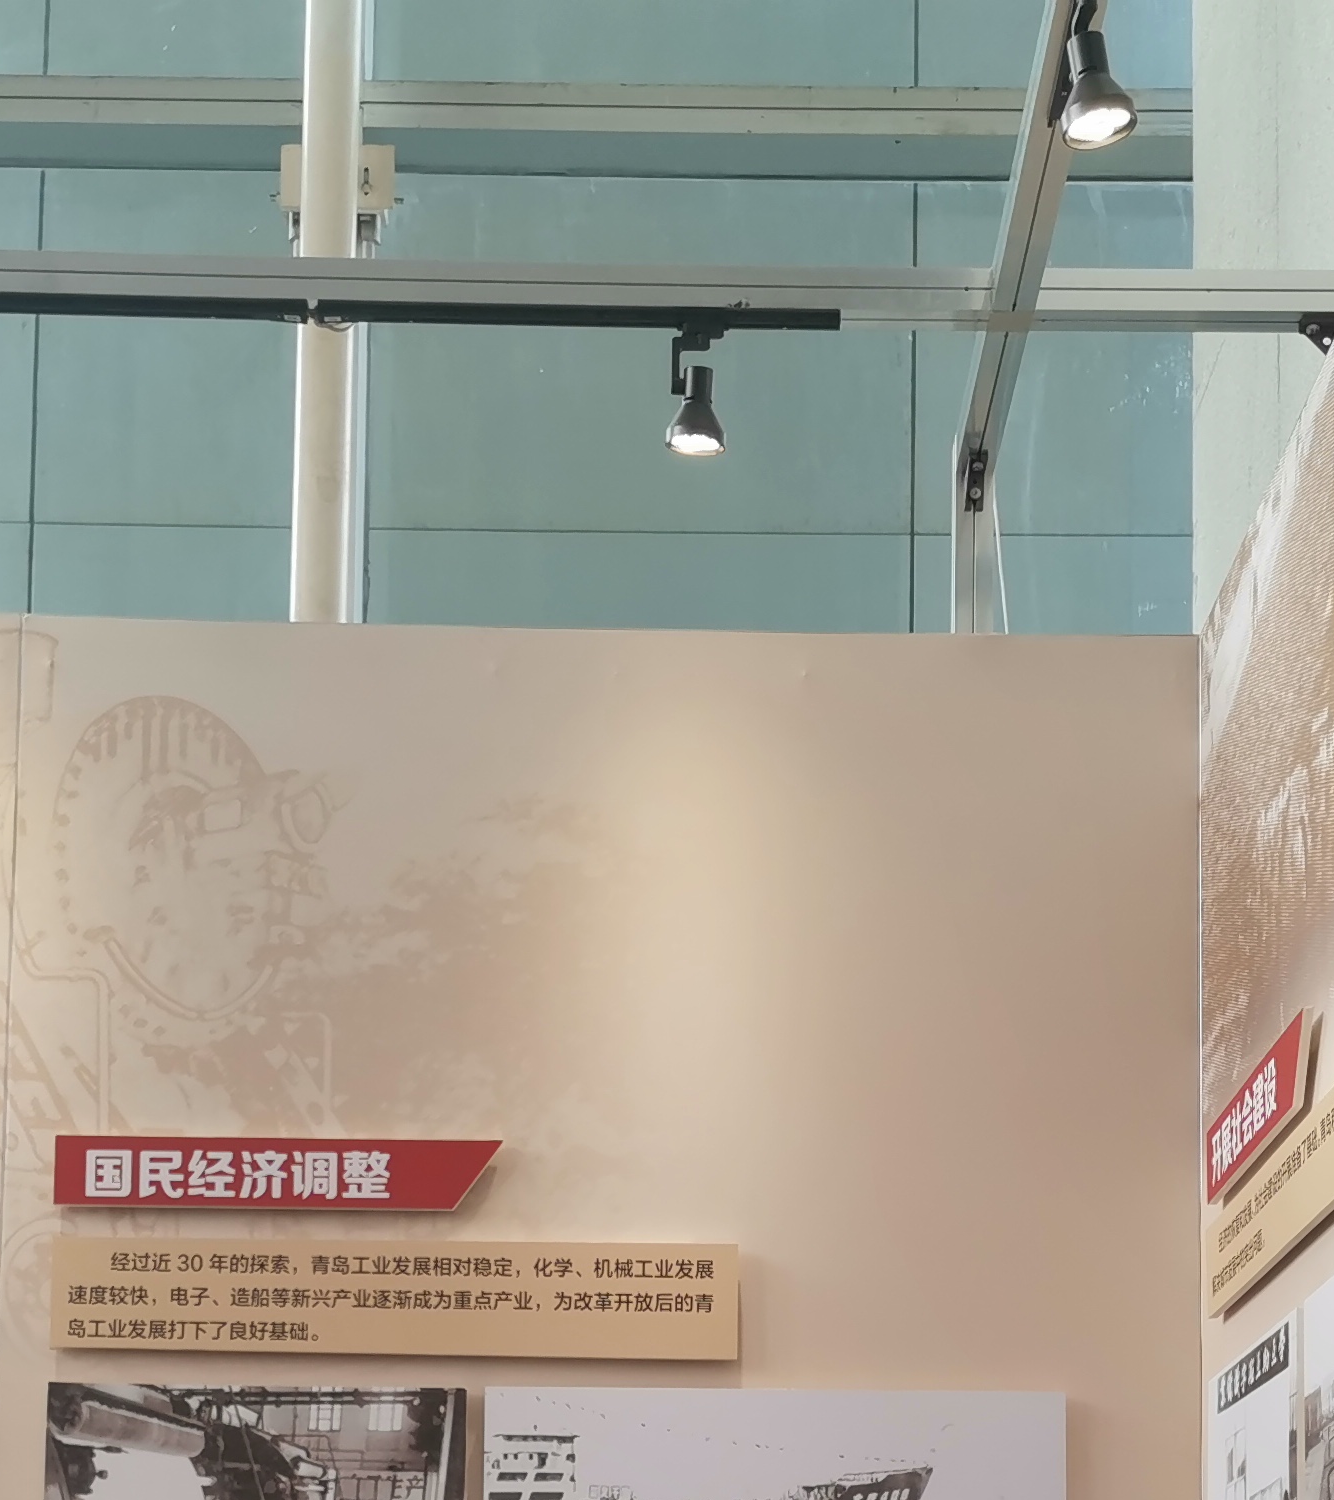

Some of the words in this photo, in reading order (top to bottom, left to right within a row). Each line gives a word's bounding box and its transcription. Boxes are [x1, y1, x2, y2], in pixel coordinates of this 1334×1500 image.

[85, 1149, 391, 1200] 国民经济调整
[67, 1317, 323, 1343] 岛工业发展打下了良好基础。
